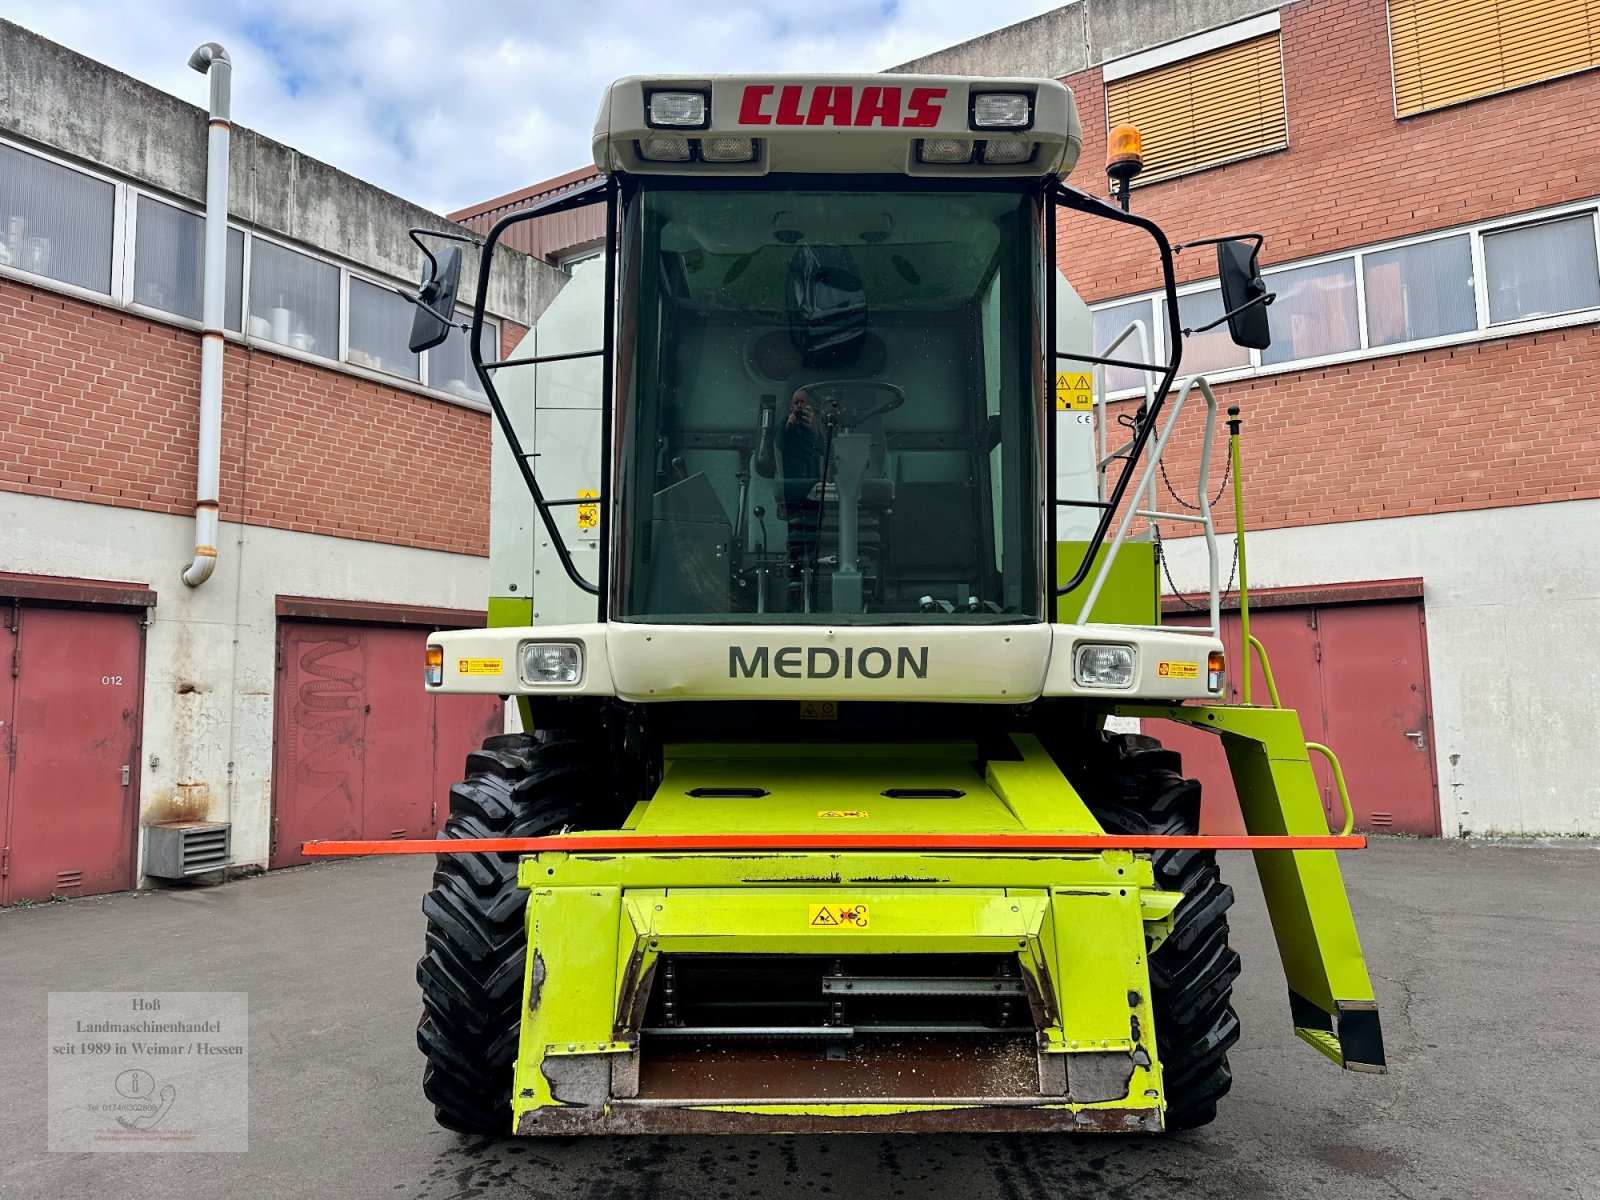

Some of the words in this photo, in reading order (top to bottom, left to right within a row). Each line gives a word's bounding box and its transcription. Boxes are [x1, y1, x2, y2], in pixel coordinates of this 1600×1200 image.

[738, 85, 948, 128] CLAAS
[729, 646, 929, 679] MEDION
[101, 675, 123, 686] 012
